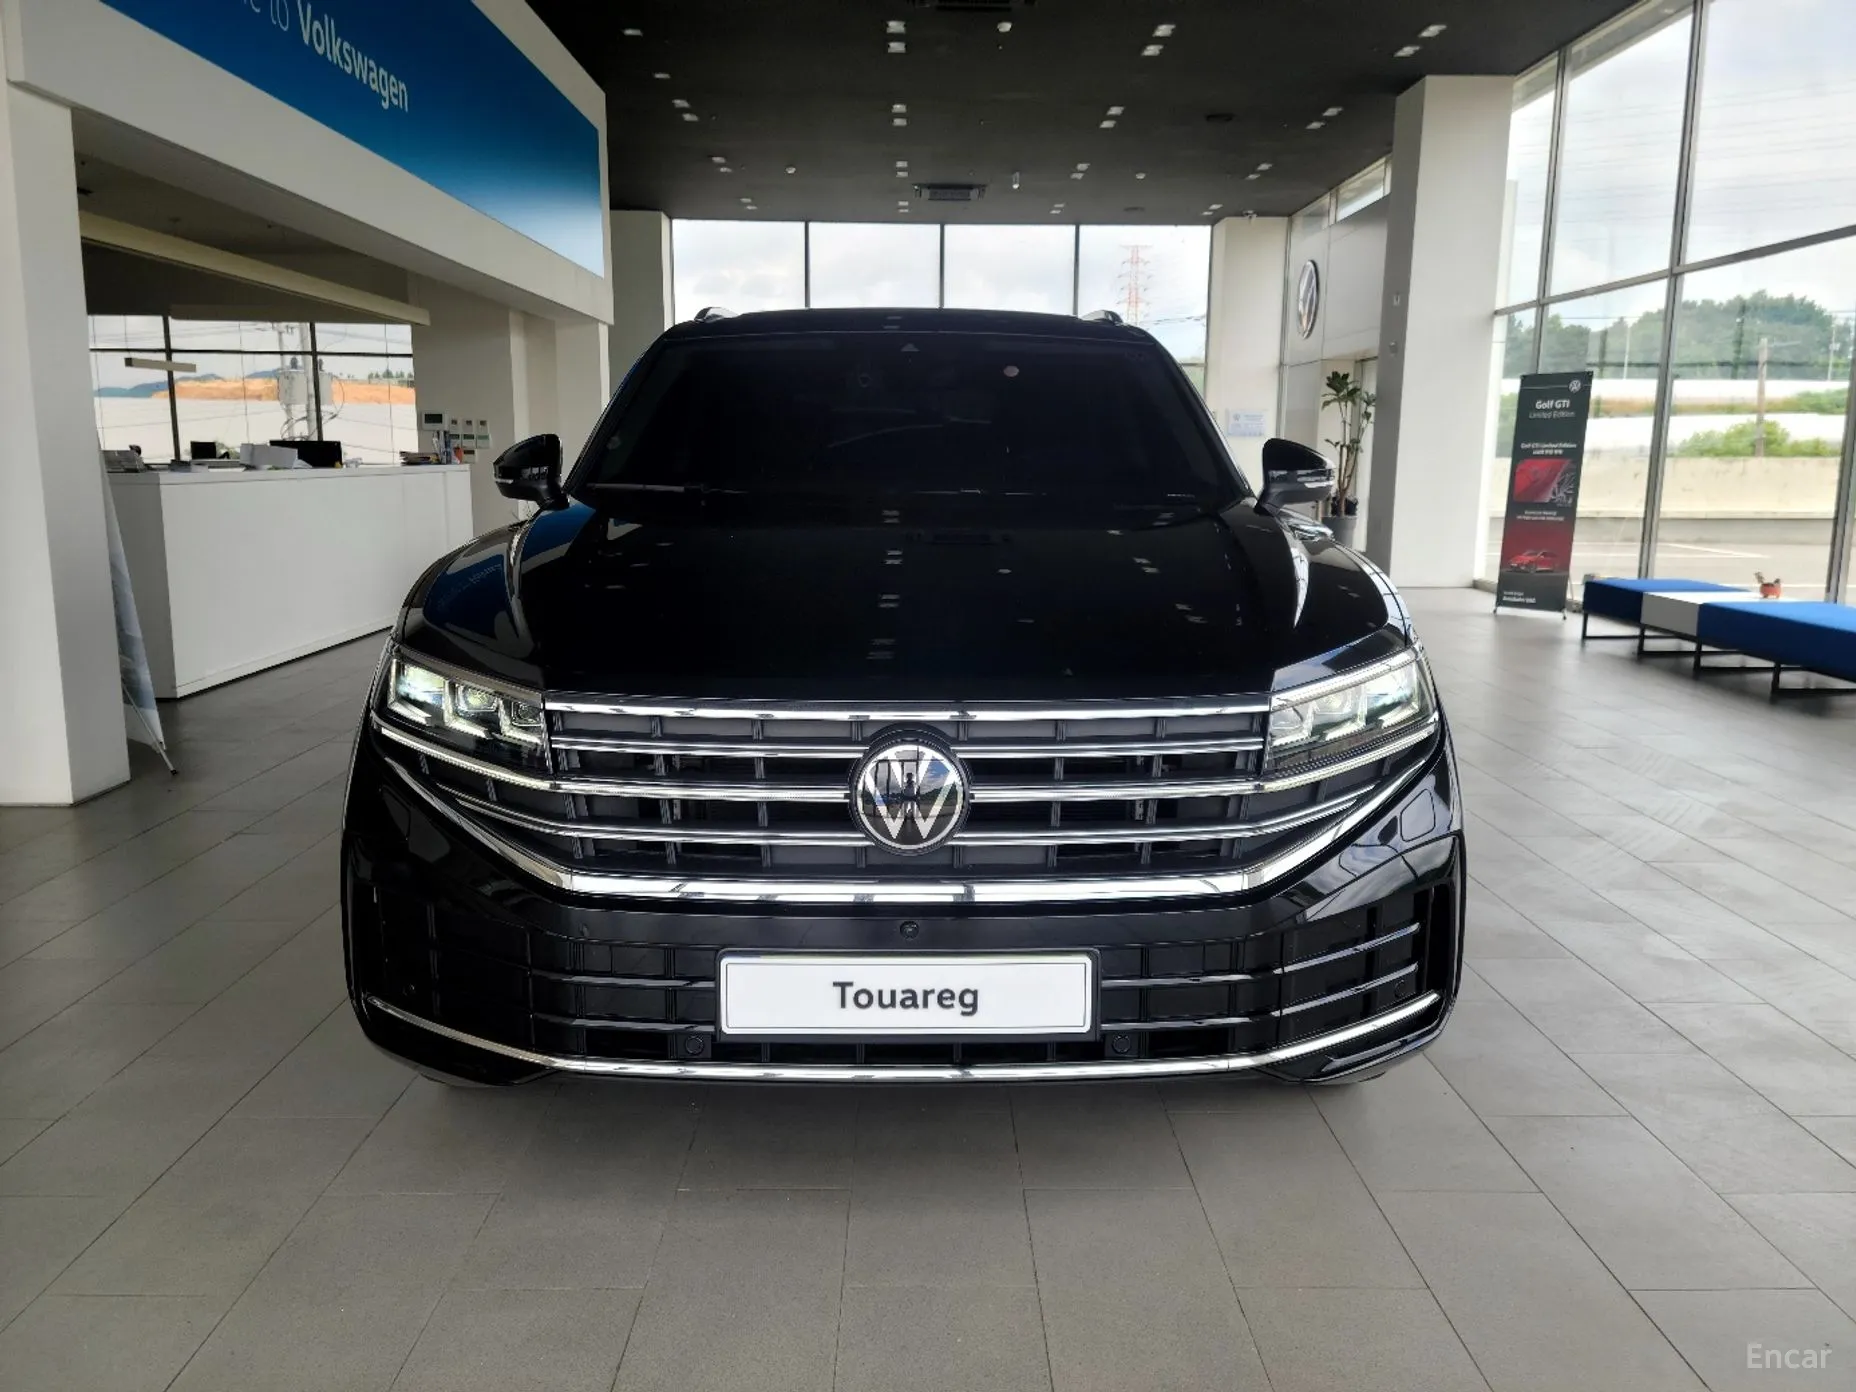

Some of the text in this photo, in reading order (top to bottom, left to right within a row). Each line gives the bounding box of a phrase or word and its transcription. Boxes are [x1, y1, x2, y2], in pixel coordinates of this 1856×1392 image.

[297, 0, 409, 112] Volkswagen
[1535, 399, 1570, 410] Golf GTI
[832, 981, 979, 1016] Touareg
